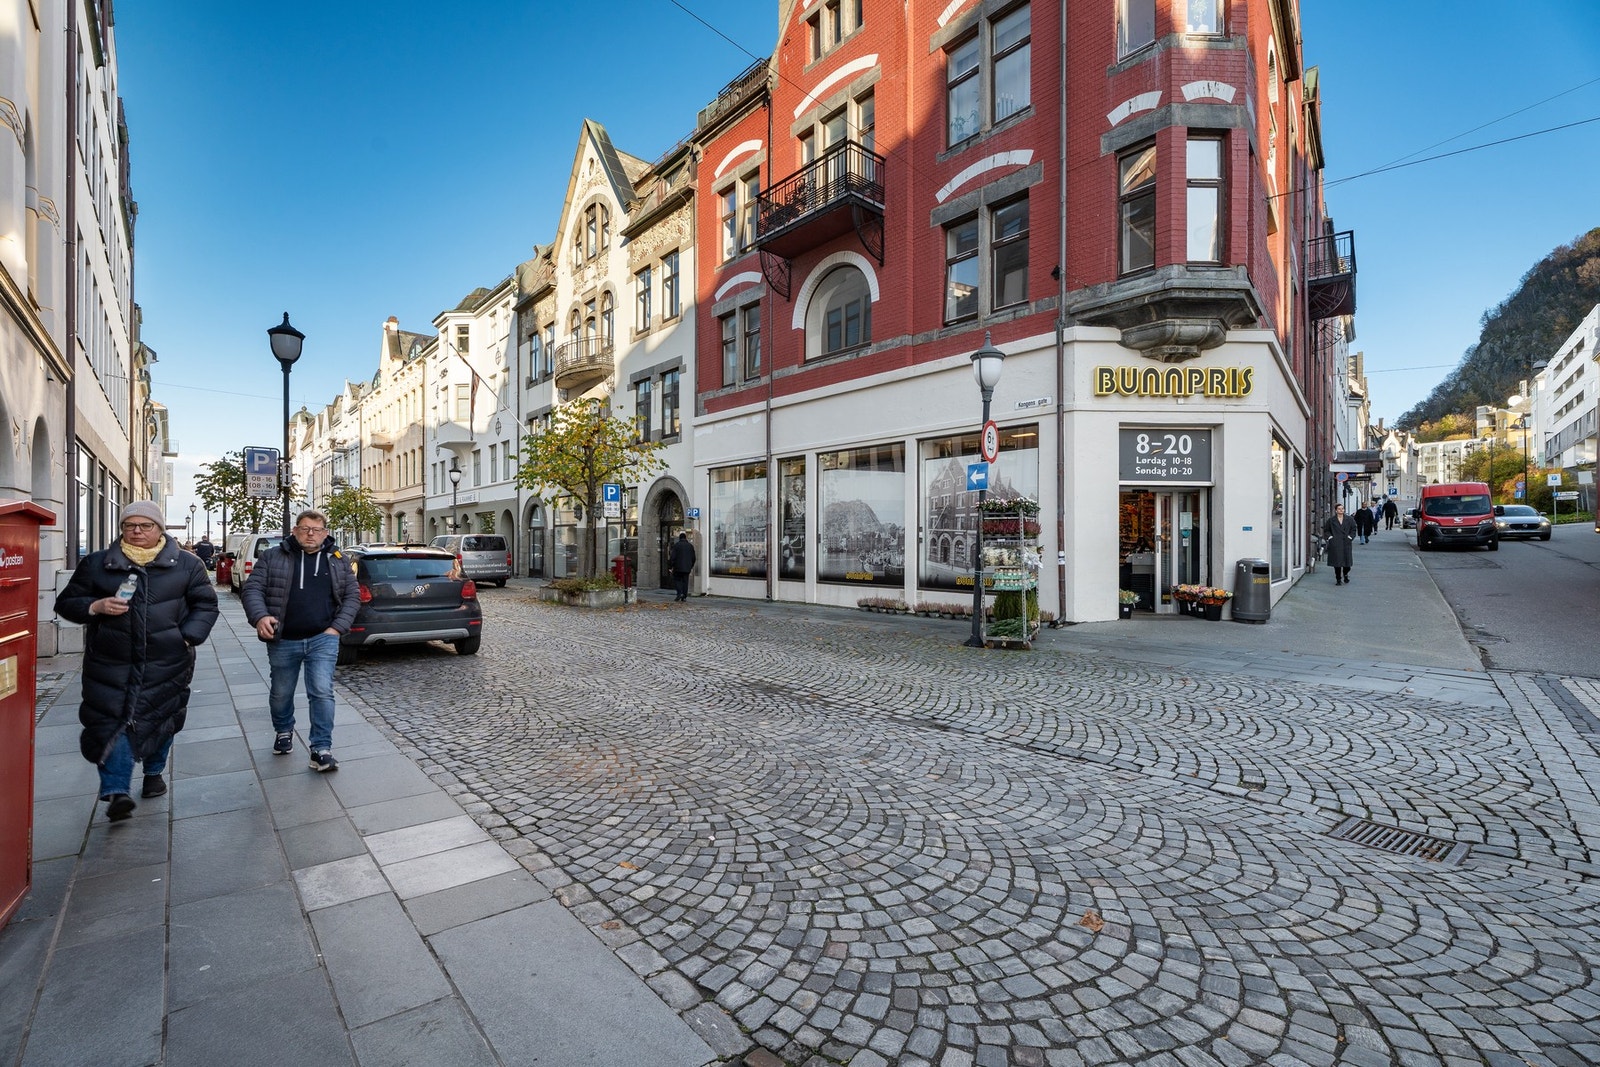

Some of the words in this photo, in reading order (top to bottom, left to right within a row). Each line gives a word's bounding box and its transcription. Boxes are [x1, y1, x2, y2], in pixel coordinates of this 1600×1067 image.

[1094, 366, 1254, 397] BUNNPRIS
[254, 452, 270, 471] P
[1136, 456, 1167, 466] Lørdag
[1172, 457, 1192, 465] 10-18
[1135, 466, 1167, 477] Søndag
[1170, 467, 1193, 475] 10-20
[607, 486, 616, 499] P
[5, 553, 24, 568] posten
